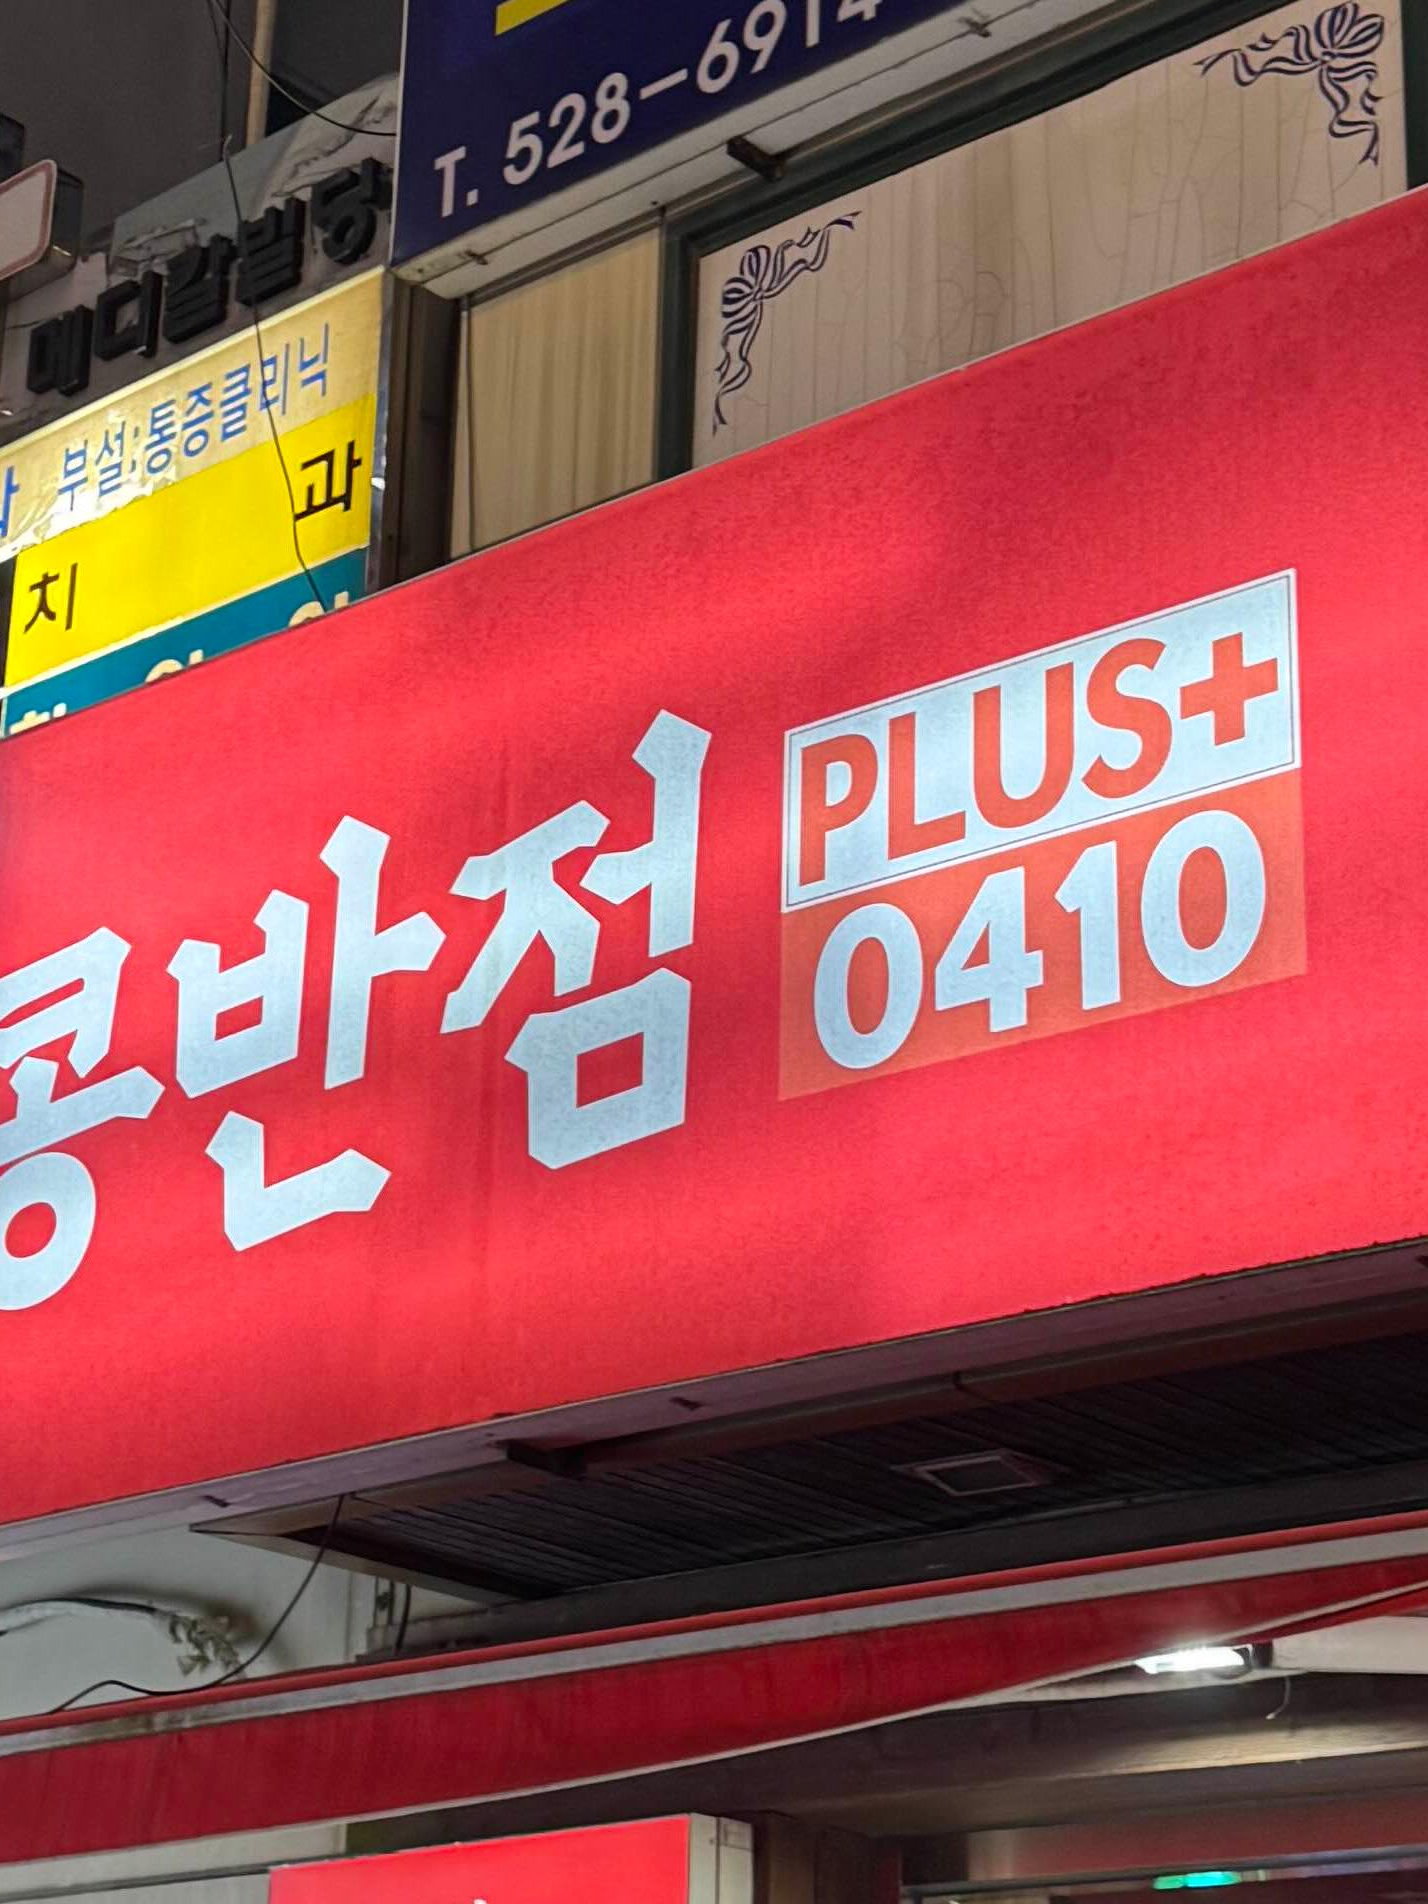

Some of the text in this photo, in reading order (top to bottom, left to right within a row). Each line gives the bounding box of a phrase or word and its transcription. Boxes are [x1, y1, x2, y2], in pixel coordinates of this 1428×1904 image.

[433, 146, 479, 219] T.
[799, 632, 1279, 887] PLUS+
[813, 809, 1266, 1069] 0410
